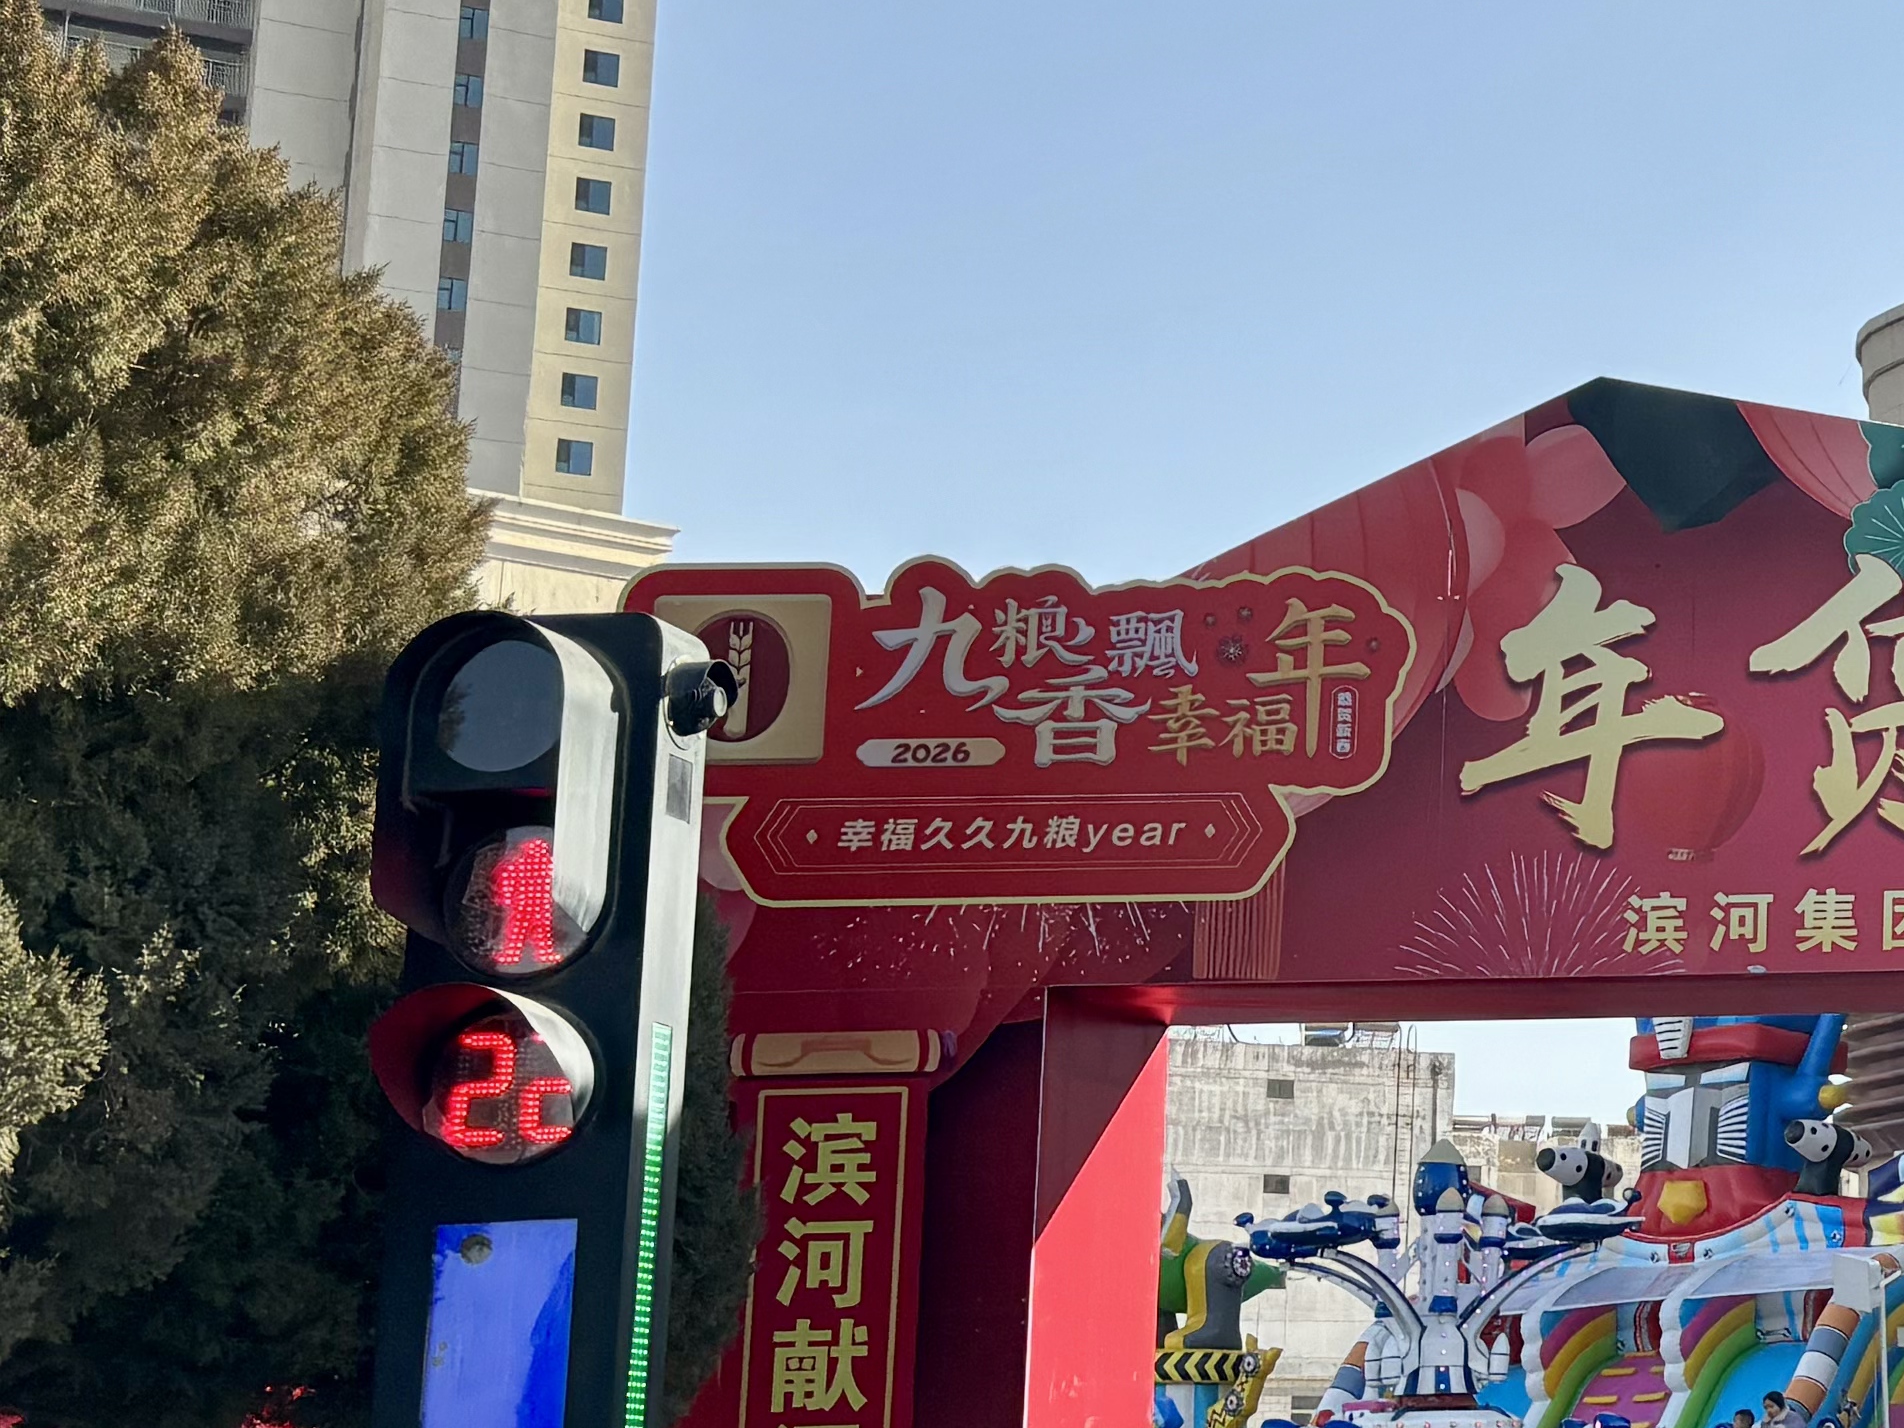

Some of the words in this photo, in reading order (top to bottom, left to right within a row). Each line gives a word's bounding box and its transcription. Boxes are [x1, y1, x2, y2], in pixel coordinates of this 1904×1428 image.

[855, 586, 1200, 768] 九粮飘香
[890, 741, 971, 765] 2026
[838, 816, 1187, 855] 幸福久久九粮year
